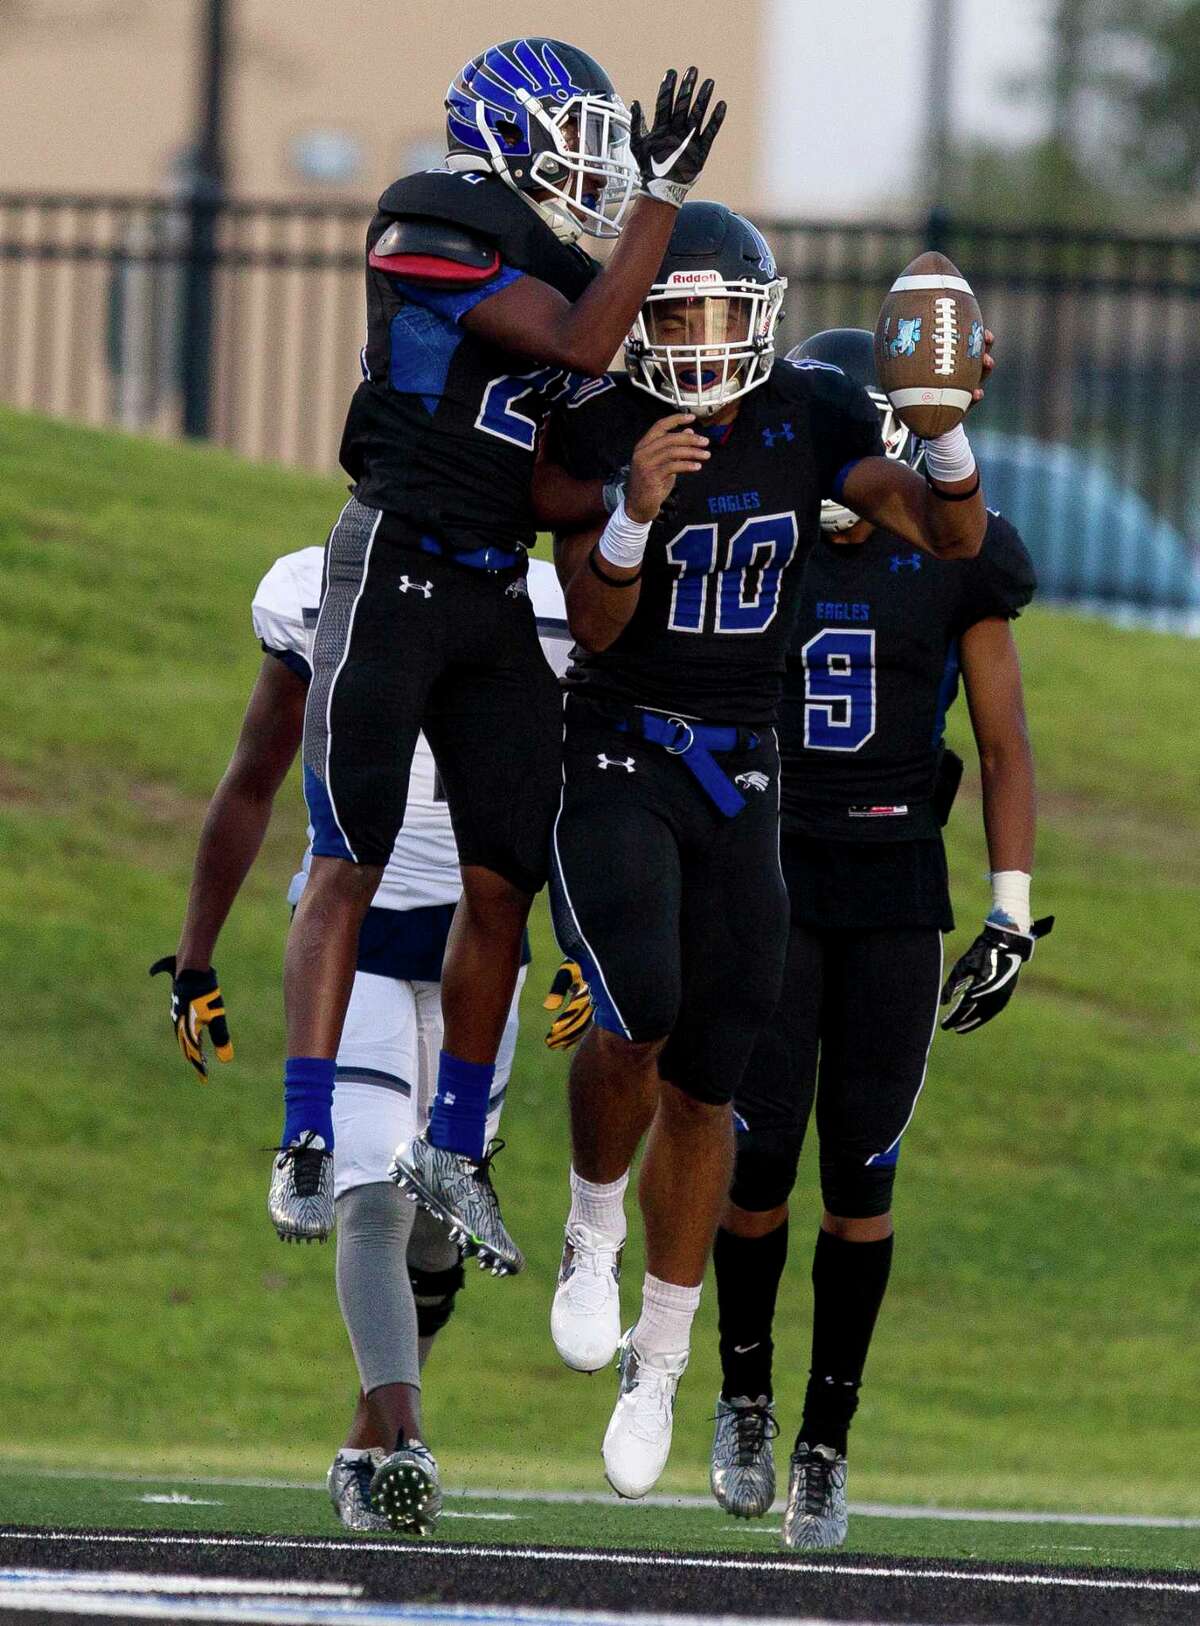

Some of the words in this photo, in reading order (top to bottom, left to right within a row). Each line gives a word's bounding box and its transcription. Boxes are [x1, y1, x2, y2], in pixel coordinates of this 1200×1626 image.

[707, 491, 761, 513] EAGLES
[666, 510, 799, 634] 10
[815, 602, 870, 621] EAGLES
[801, 628, 876, 752] 9
